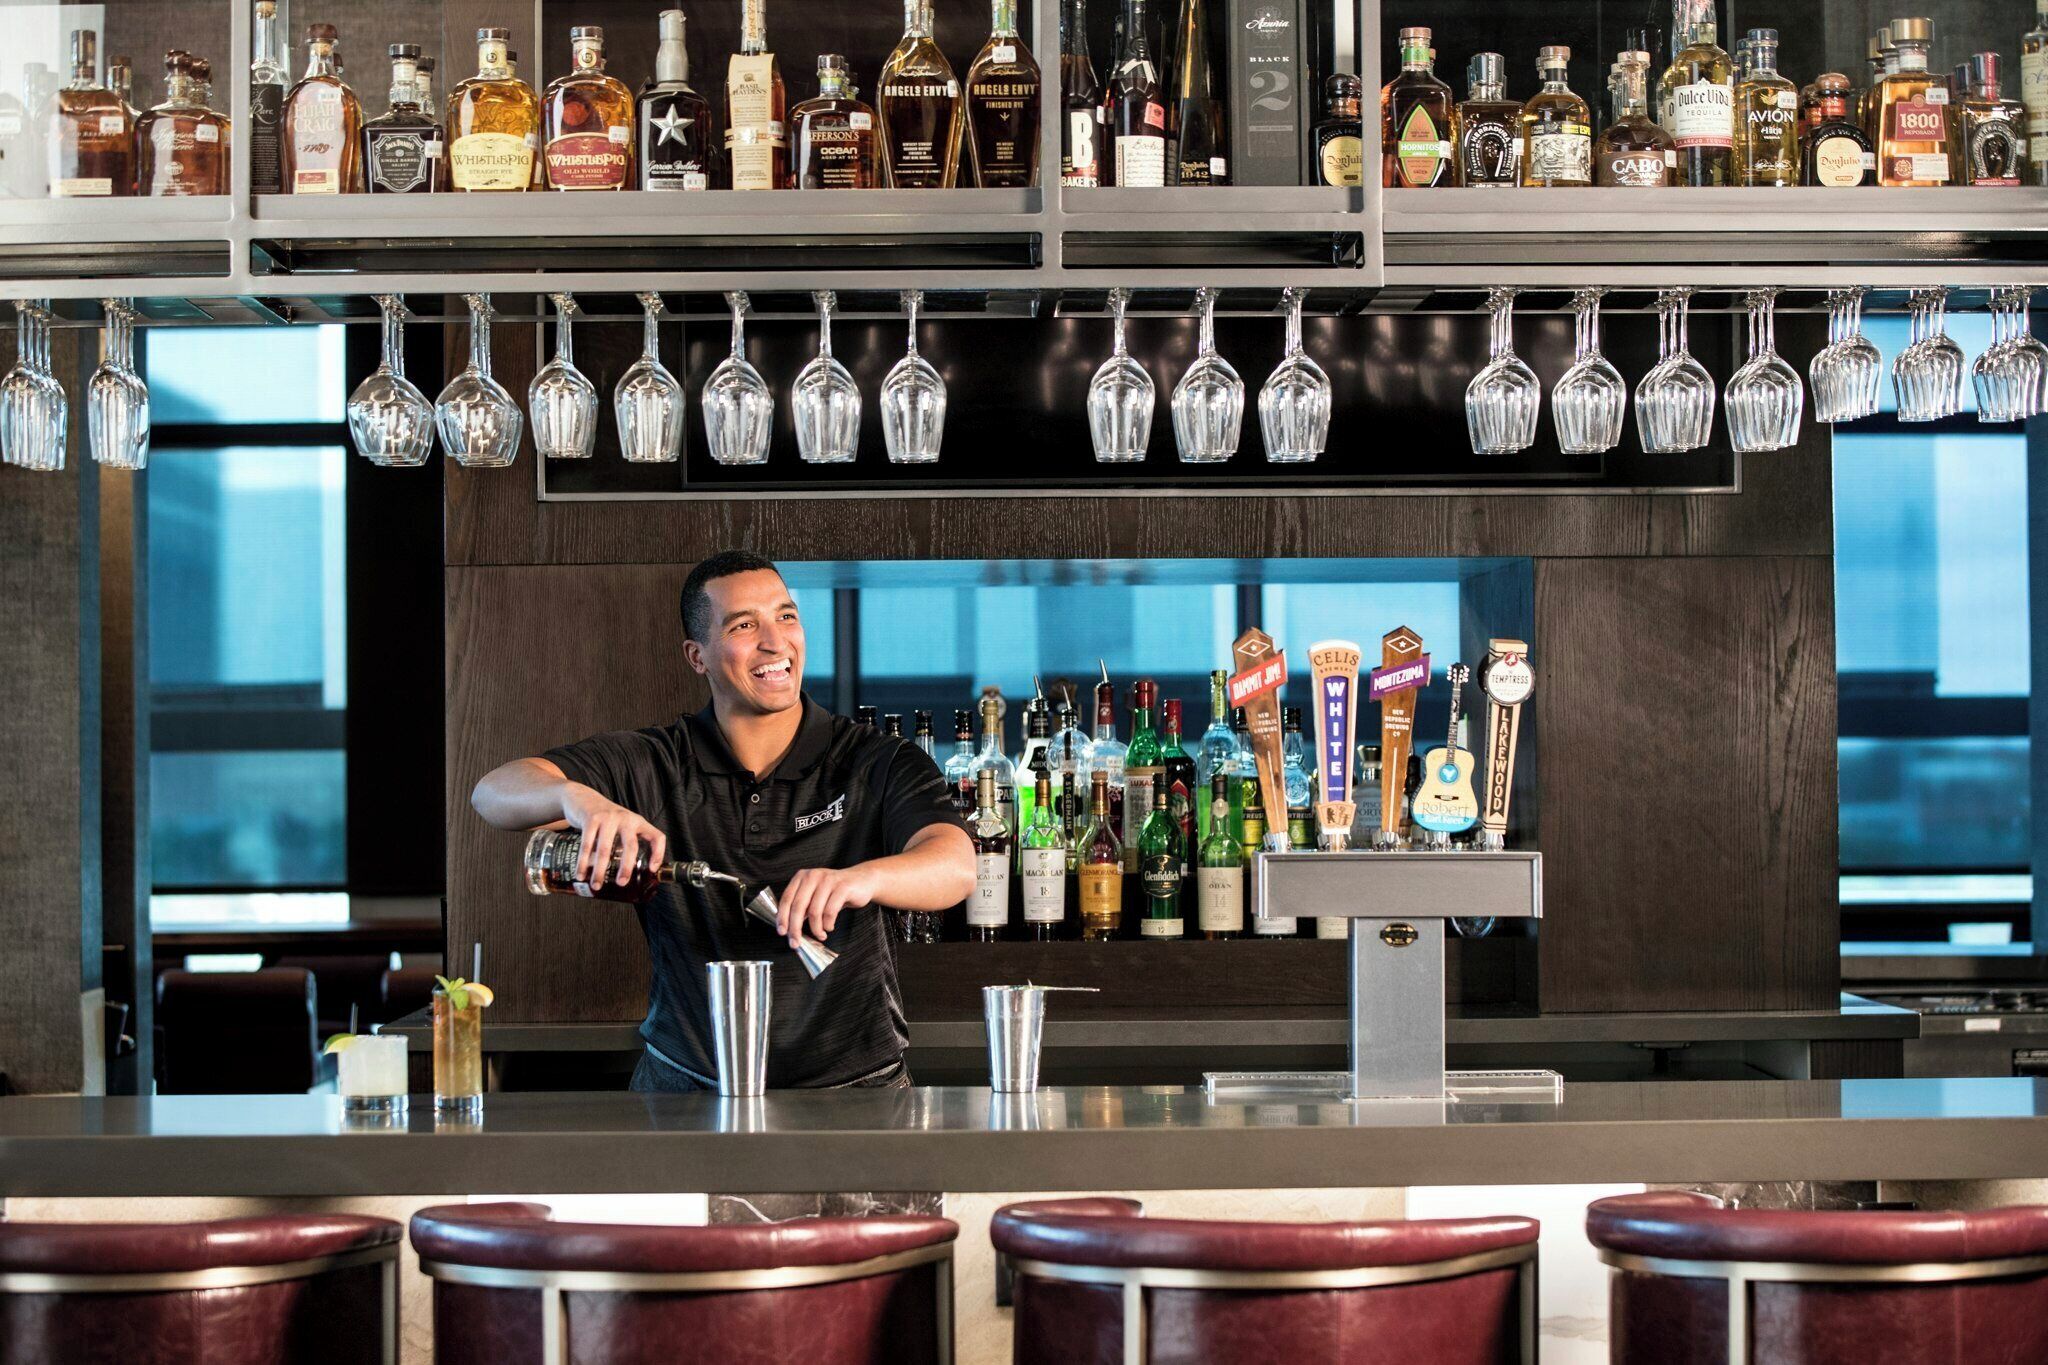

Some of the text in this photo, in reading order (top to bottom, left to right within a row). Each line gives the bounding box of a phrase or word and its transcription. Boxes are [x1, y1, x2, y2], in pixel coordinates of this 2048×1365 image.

[923, 85, 948, 97] ENVY
[1012, 84, 1036, 95] ENVY
[1250, 70, 1292, 112] 2
[1678, 89, 1729, 107] Dulce Vida
[294, 103, 335, 118] ELIJAH
[1747, 108, 1795, 123] AVIÓN
[294, 119, 335, 133] CRAIG
[1899, 112, 1939, 129] 1800
[806, 130, 860, 140] EFFERSON'S
[1470, 125, 1512, 143] HERRADURA
[1400, 143, 1440, 151] HORNITOS
[1345, 154, 1363, 168] Juli
[1611, 158, 1665, 174] CABO
[1060, 176, 1098, 187] BAKER'S
[1181, 170, 1209, 178] 1942
[1313, 651, 1360, 666] CELIS
[1373, 664, 1424, 691] MONTEZUMA
[1491, 674, 1530, 684] TEMPTRESS
[1326, 681, 1346, 776] WHITE
[1492, 708, 1510, 811] LAKEWOOD
[1063, 781, 1073, 830] ST-GERMAIN
[1421, 801, 1471, 820] Robert
[797, 808, 834, 829] BLOCK
[1144, 871, 1180, 881] Glenfiddich
[981, 888, 993, 898] 12
[1157, 926, 1165, 934] 12
